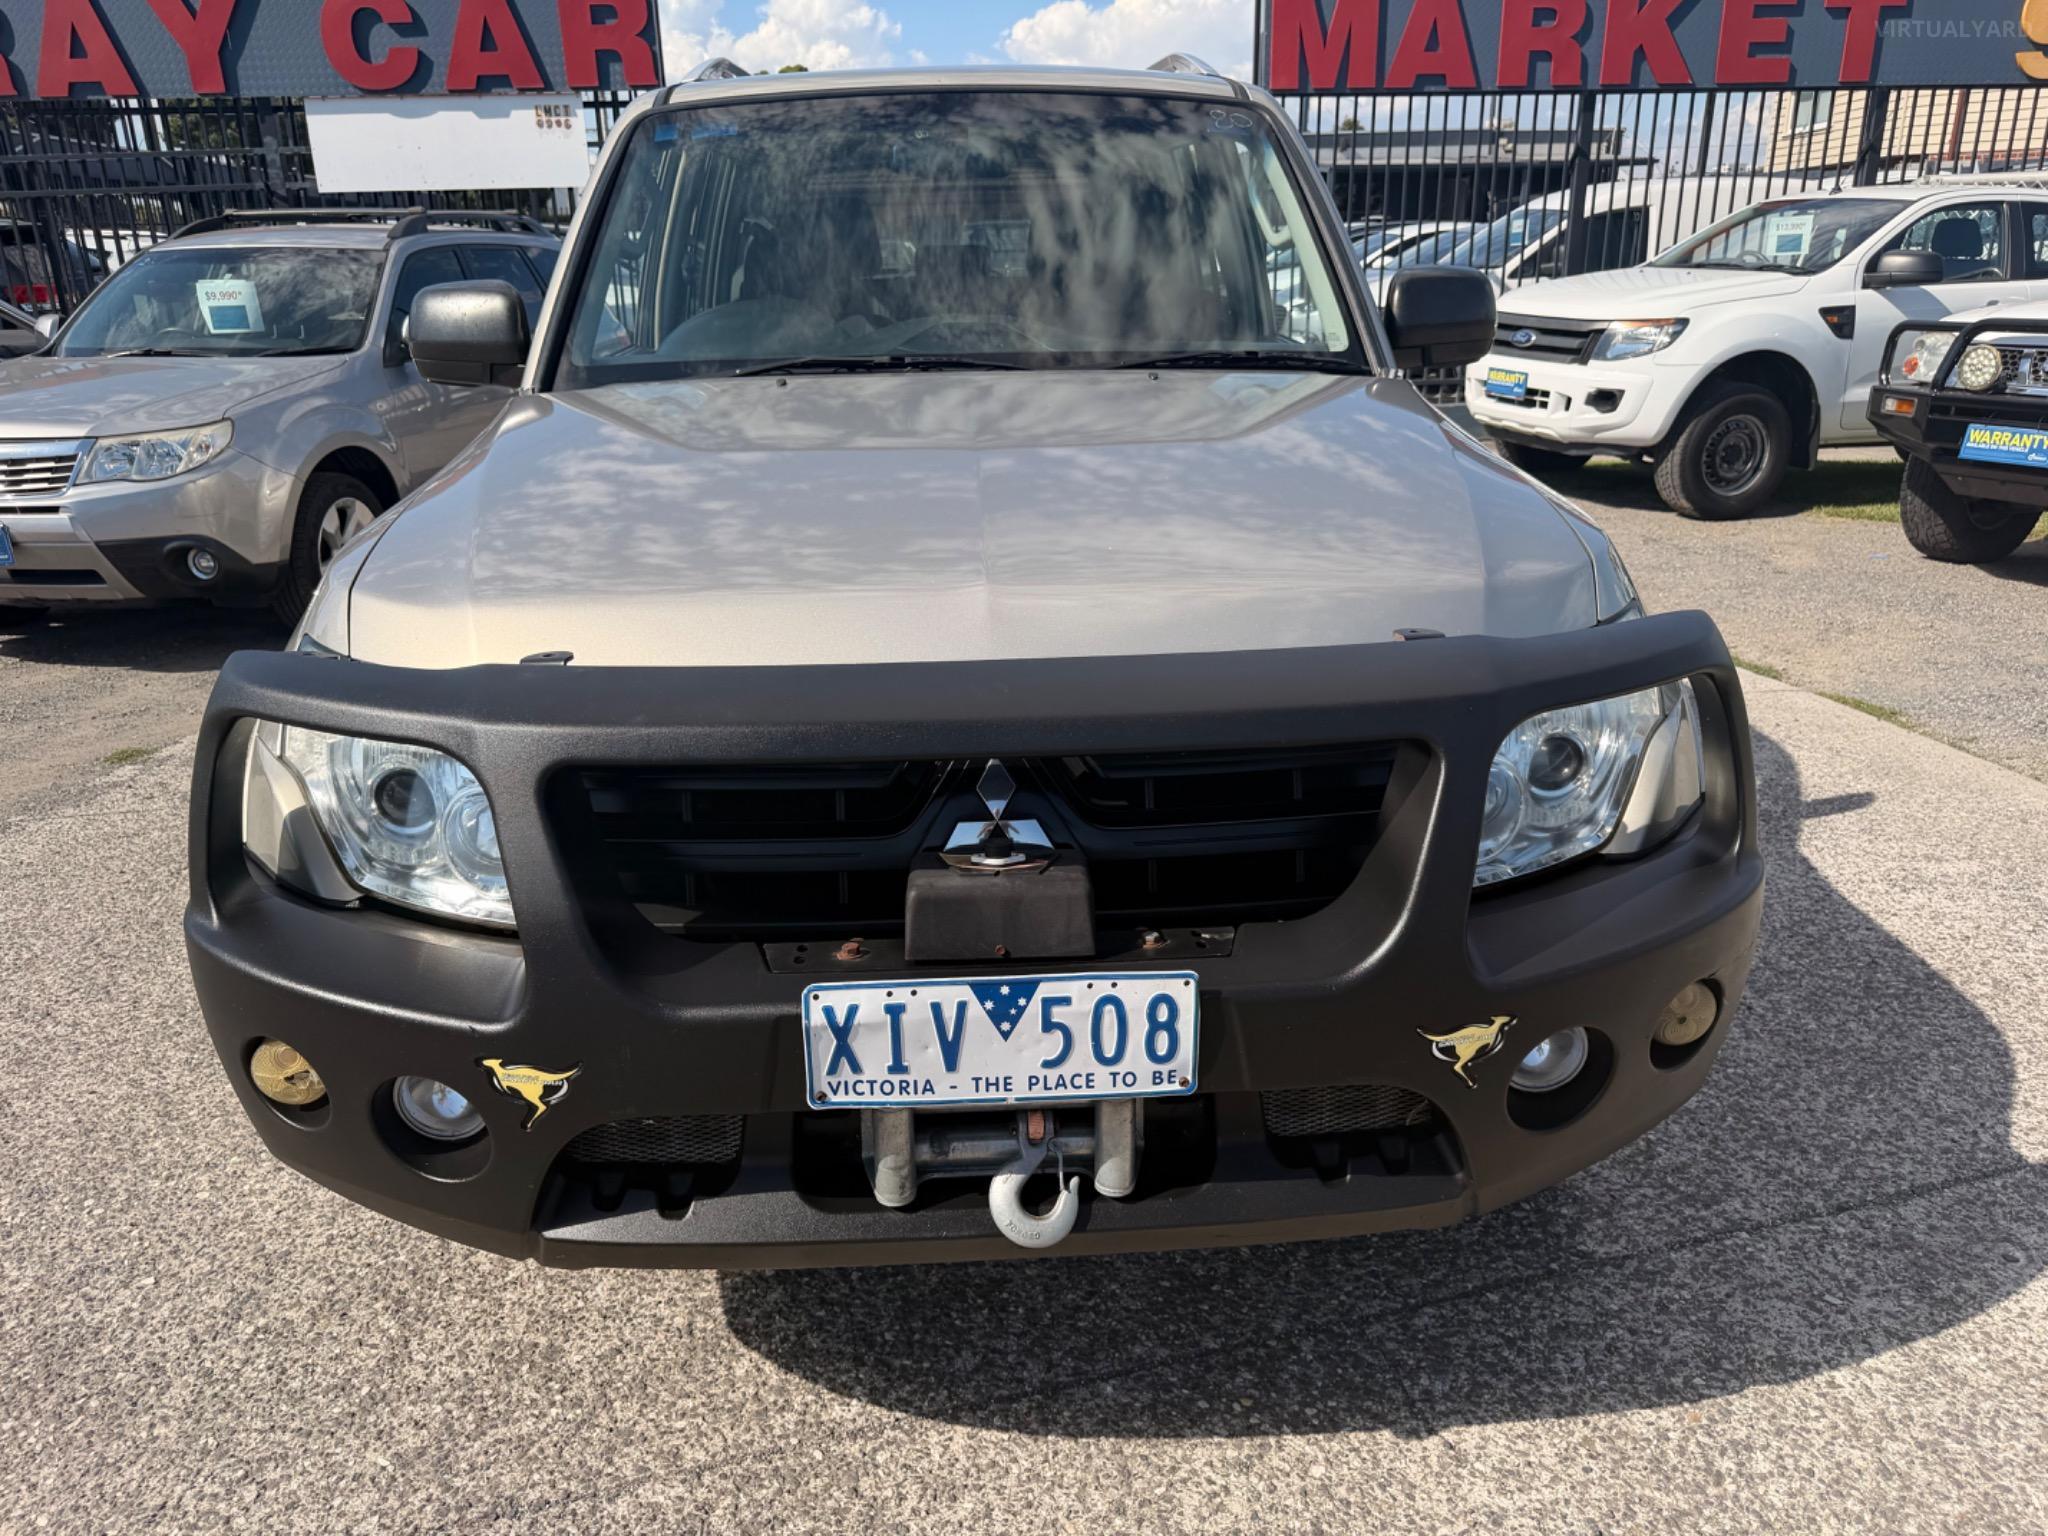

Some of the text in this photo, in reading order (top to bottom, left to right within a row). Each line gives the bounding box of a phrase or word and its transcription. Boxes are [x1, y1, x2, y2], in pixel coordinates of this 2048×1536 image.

[0, 0, 659, 97] AY CAR
[1270, 0, 1908, 89] MARKET
[822, 993, 1181, 1076] XIV 508
[827, 1078, 936, 1097] VICTORIA
[971, 1076, 1014, 1093] THE
[1028, 1072, 1096, 1091] PLACE
[1109, 1071, 1137, 1088] TO
[1152, 1069, 1178, 1085] BE
